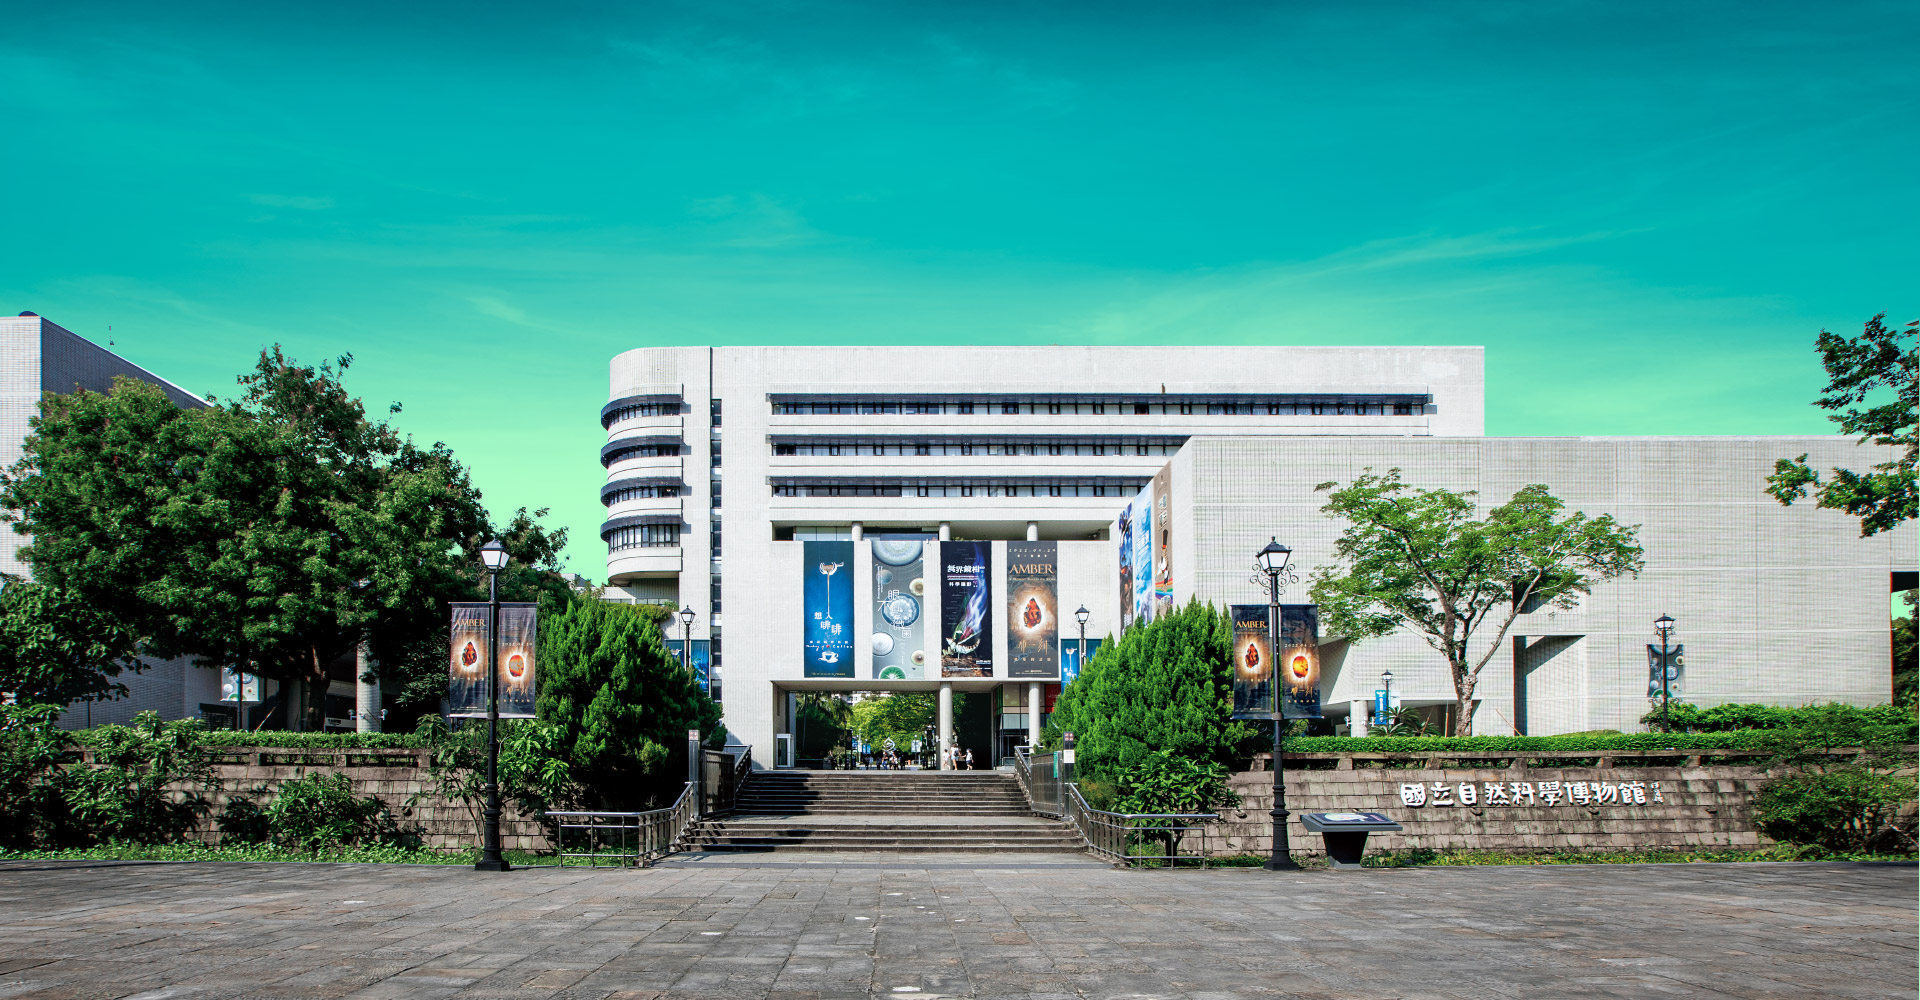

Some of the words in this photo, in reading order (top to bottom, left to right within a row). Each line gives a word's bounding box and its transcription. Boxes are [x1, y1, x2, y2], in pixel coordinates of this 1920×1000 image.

[1009, 563, 1055, 575] AMBER
[453, 619, 486, 627] AMBER
[1235, 620, 1267, 629] AMBER
[1400, 781, 1647, 807] 國立自然科學博物館
